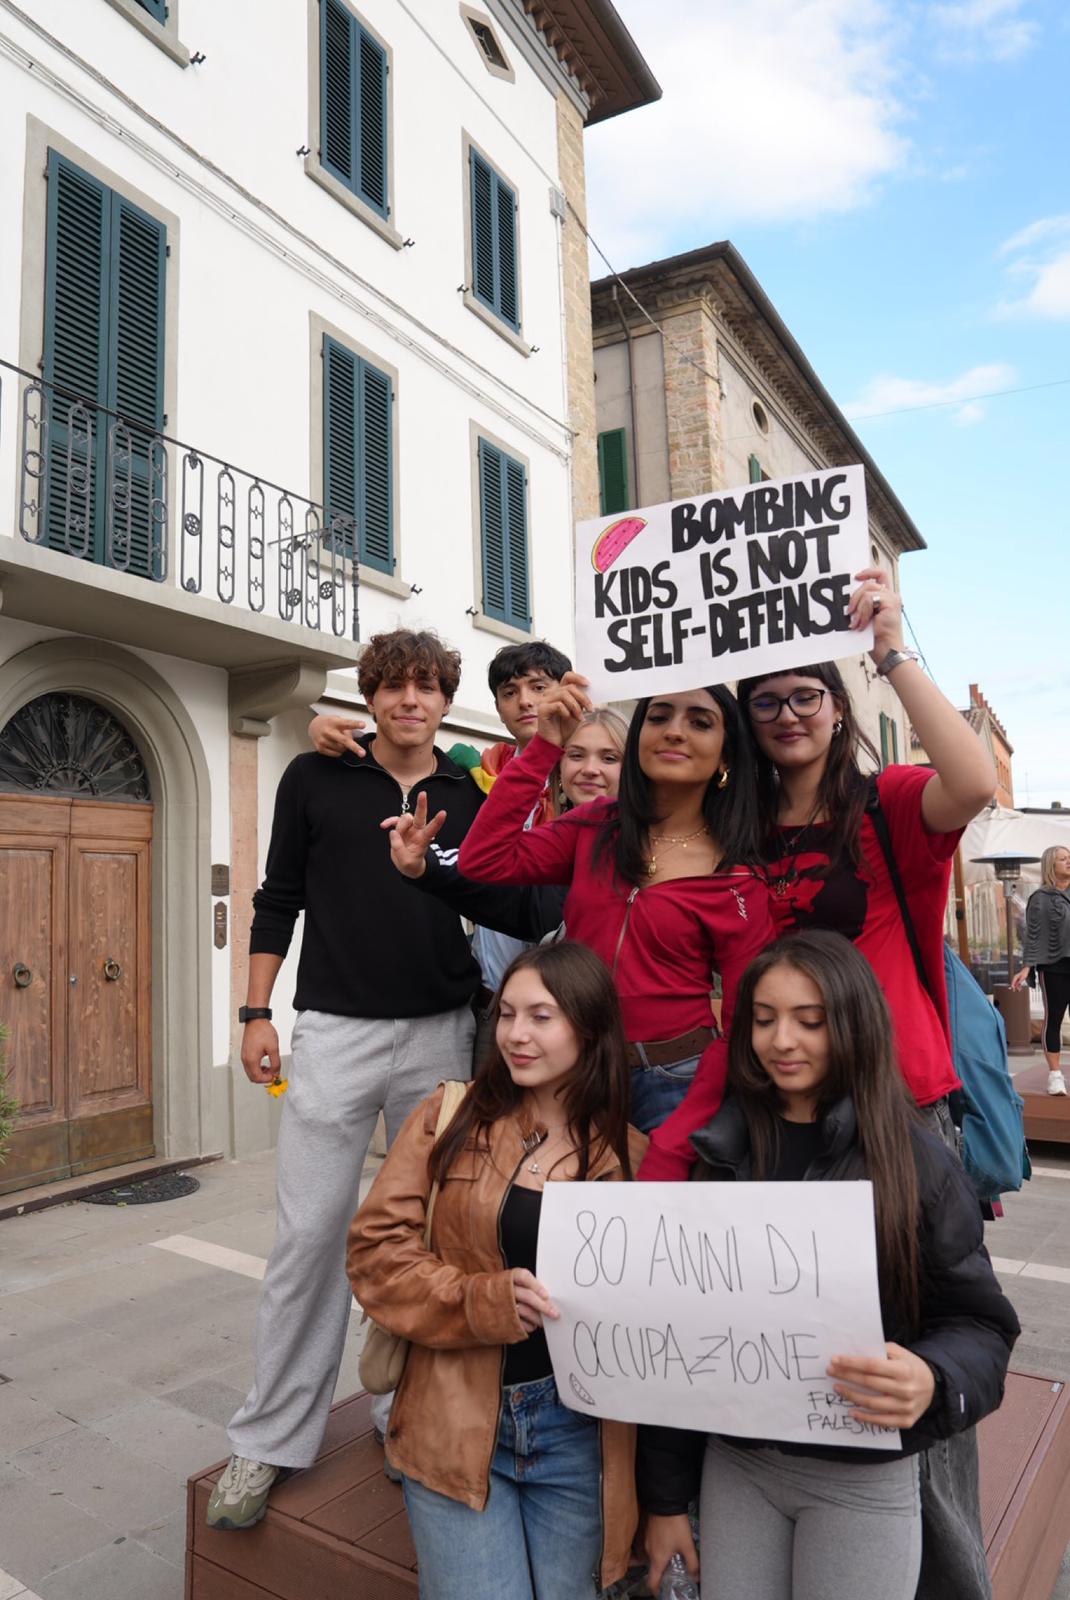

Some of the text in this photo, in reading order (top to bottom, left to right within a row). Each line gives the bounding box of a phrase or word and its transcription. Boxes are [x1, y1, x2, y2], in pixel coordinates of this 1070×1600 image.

[671, 474, 851, 553] BOMBING
[594, 524, 840, 618] KIDS IS NOT
[604, 573, 852, 673] SELF-DEFENSE
[573, 1210, 819, 1298] 80 ANNI DI
[573, 1320, 829, 1385] OCCUPAZIONE
[807, 1391, 863, 1410] FRE
